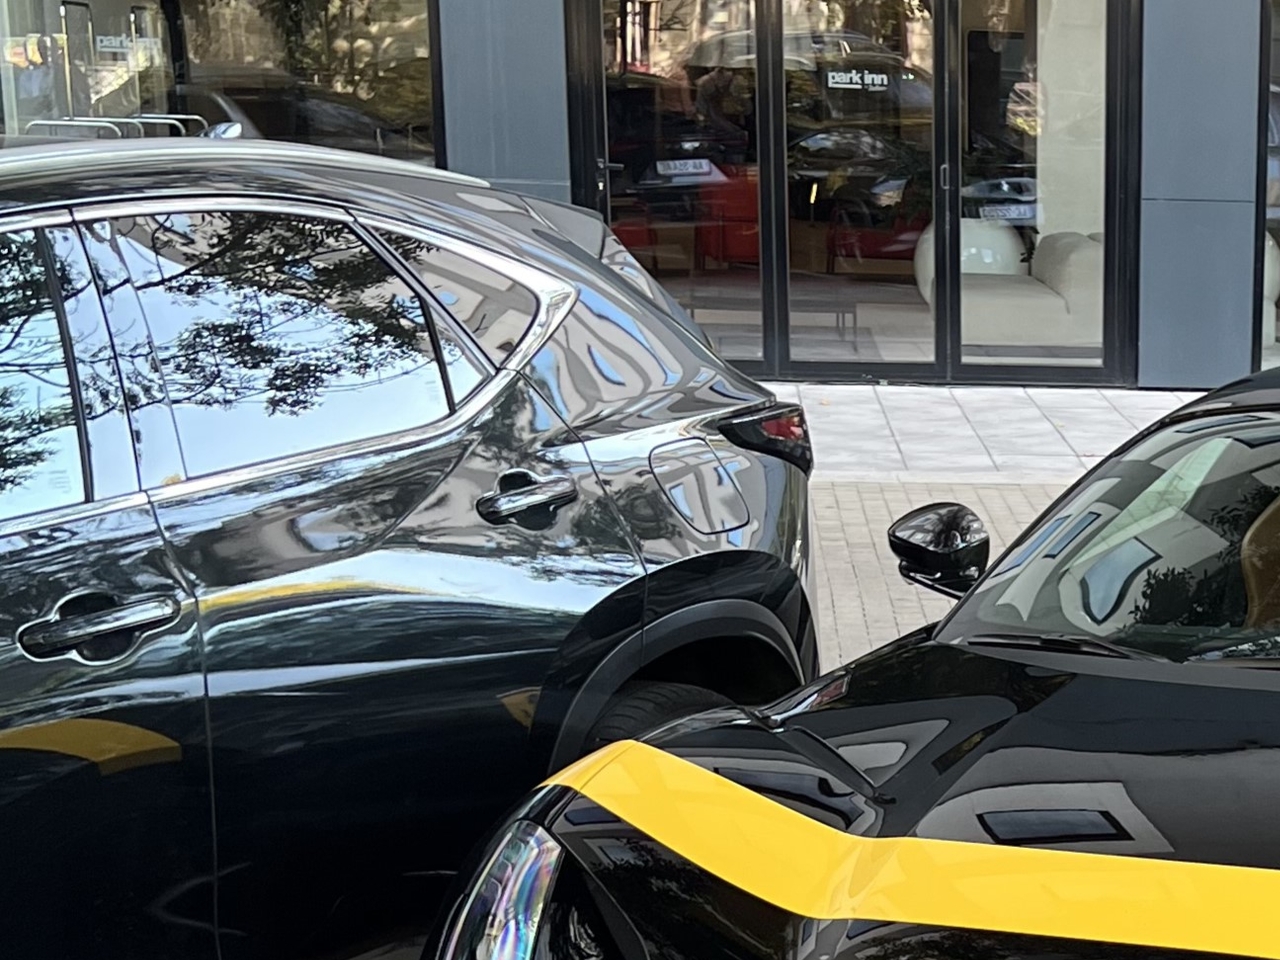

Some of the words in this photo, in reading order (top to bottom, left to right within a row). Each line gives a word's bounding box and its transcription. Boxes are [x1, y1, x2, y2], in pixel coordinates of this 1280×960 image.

[96, 33, 132, 51] park
[827, 69, 862, 88] park
[864, 70, 888, 85] inn
